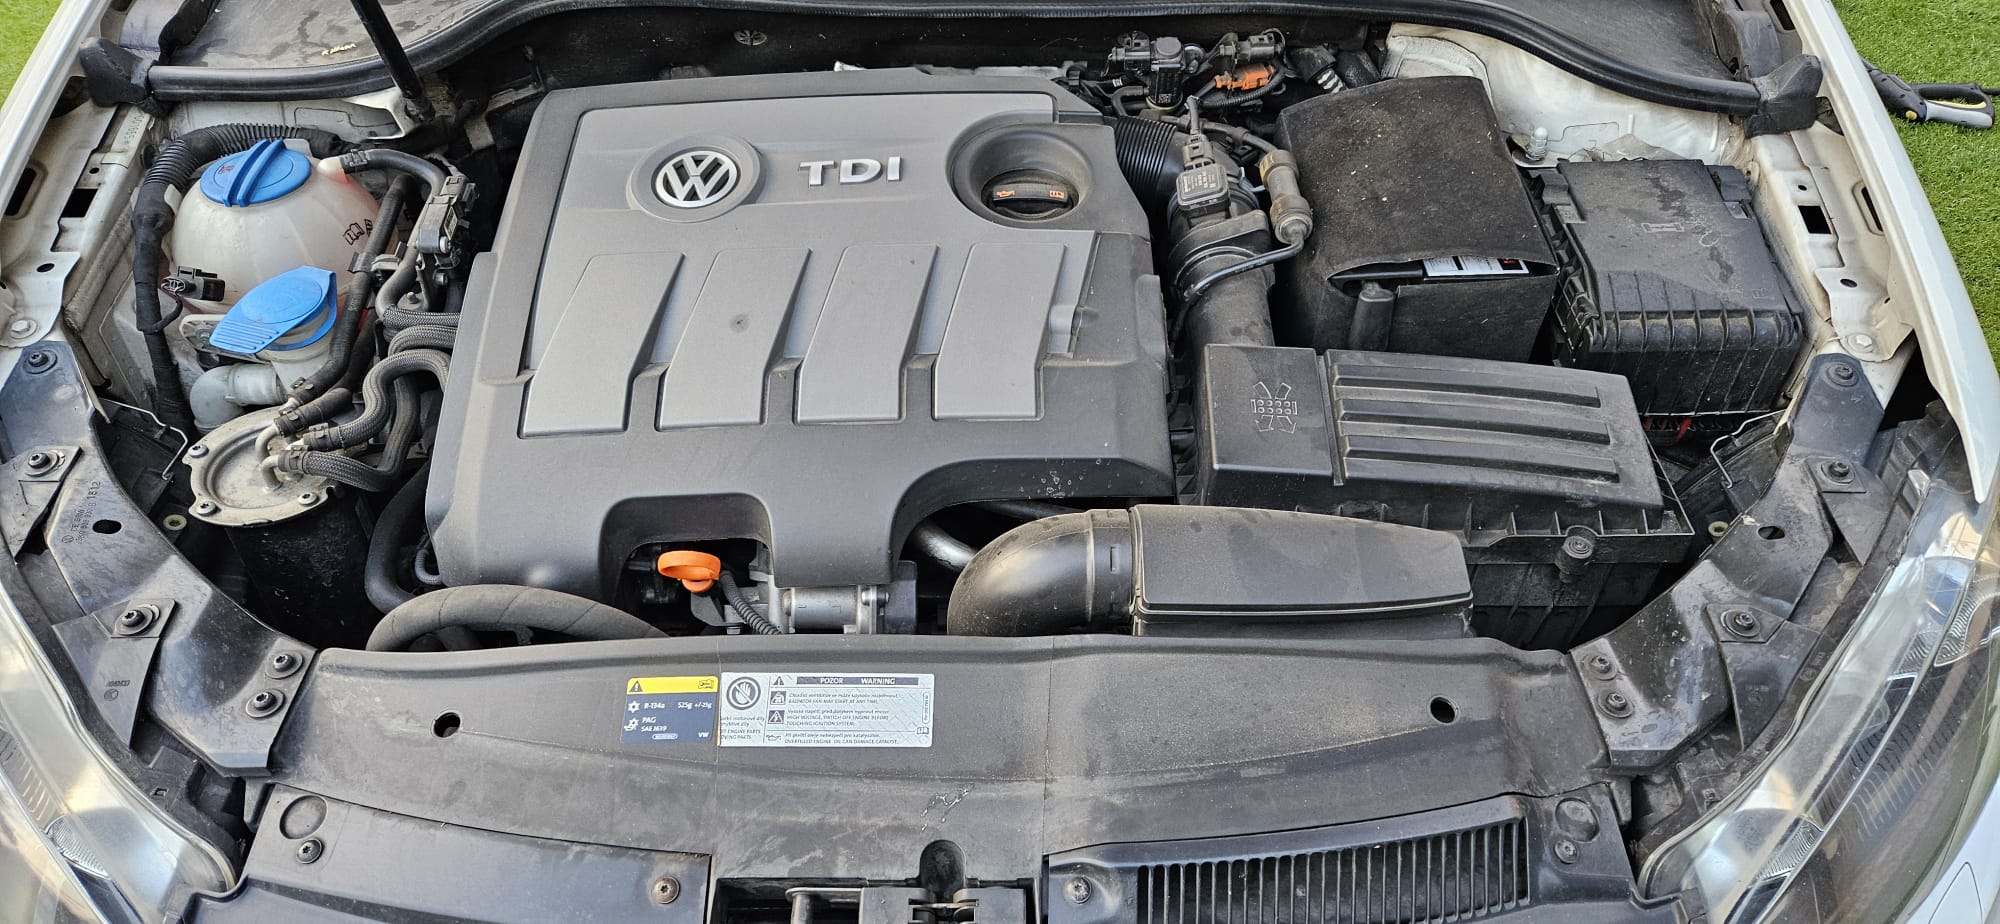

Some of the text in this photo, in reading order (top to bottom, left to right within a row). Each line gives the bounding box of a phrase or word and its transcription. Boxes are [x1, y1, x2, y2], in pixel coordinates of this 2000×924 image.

[799, 156, 903, 187] TDI
[861, 677, 896, 685] WARNING
[643, 702, 666, 710] R-134a
[642, 716, 656, 724] PAG
